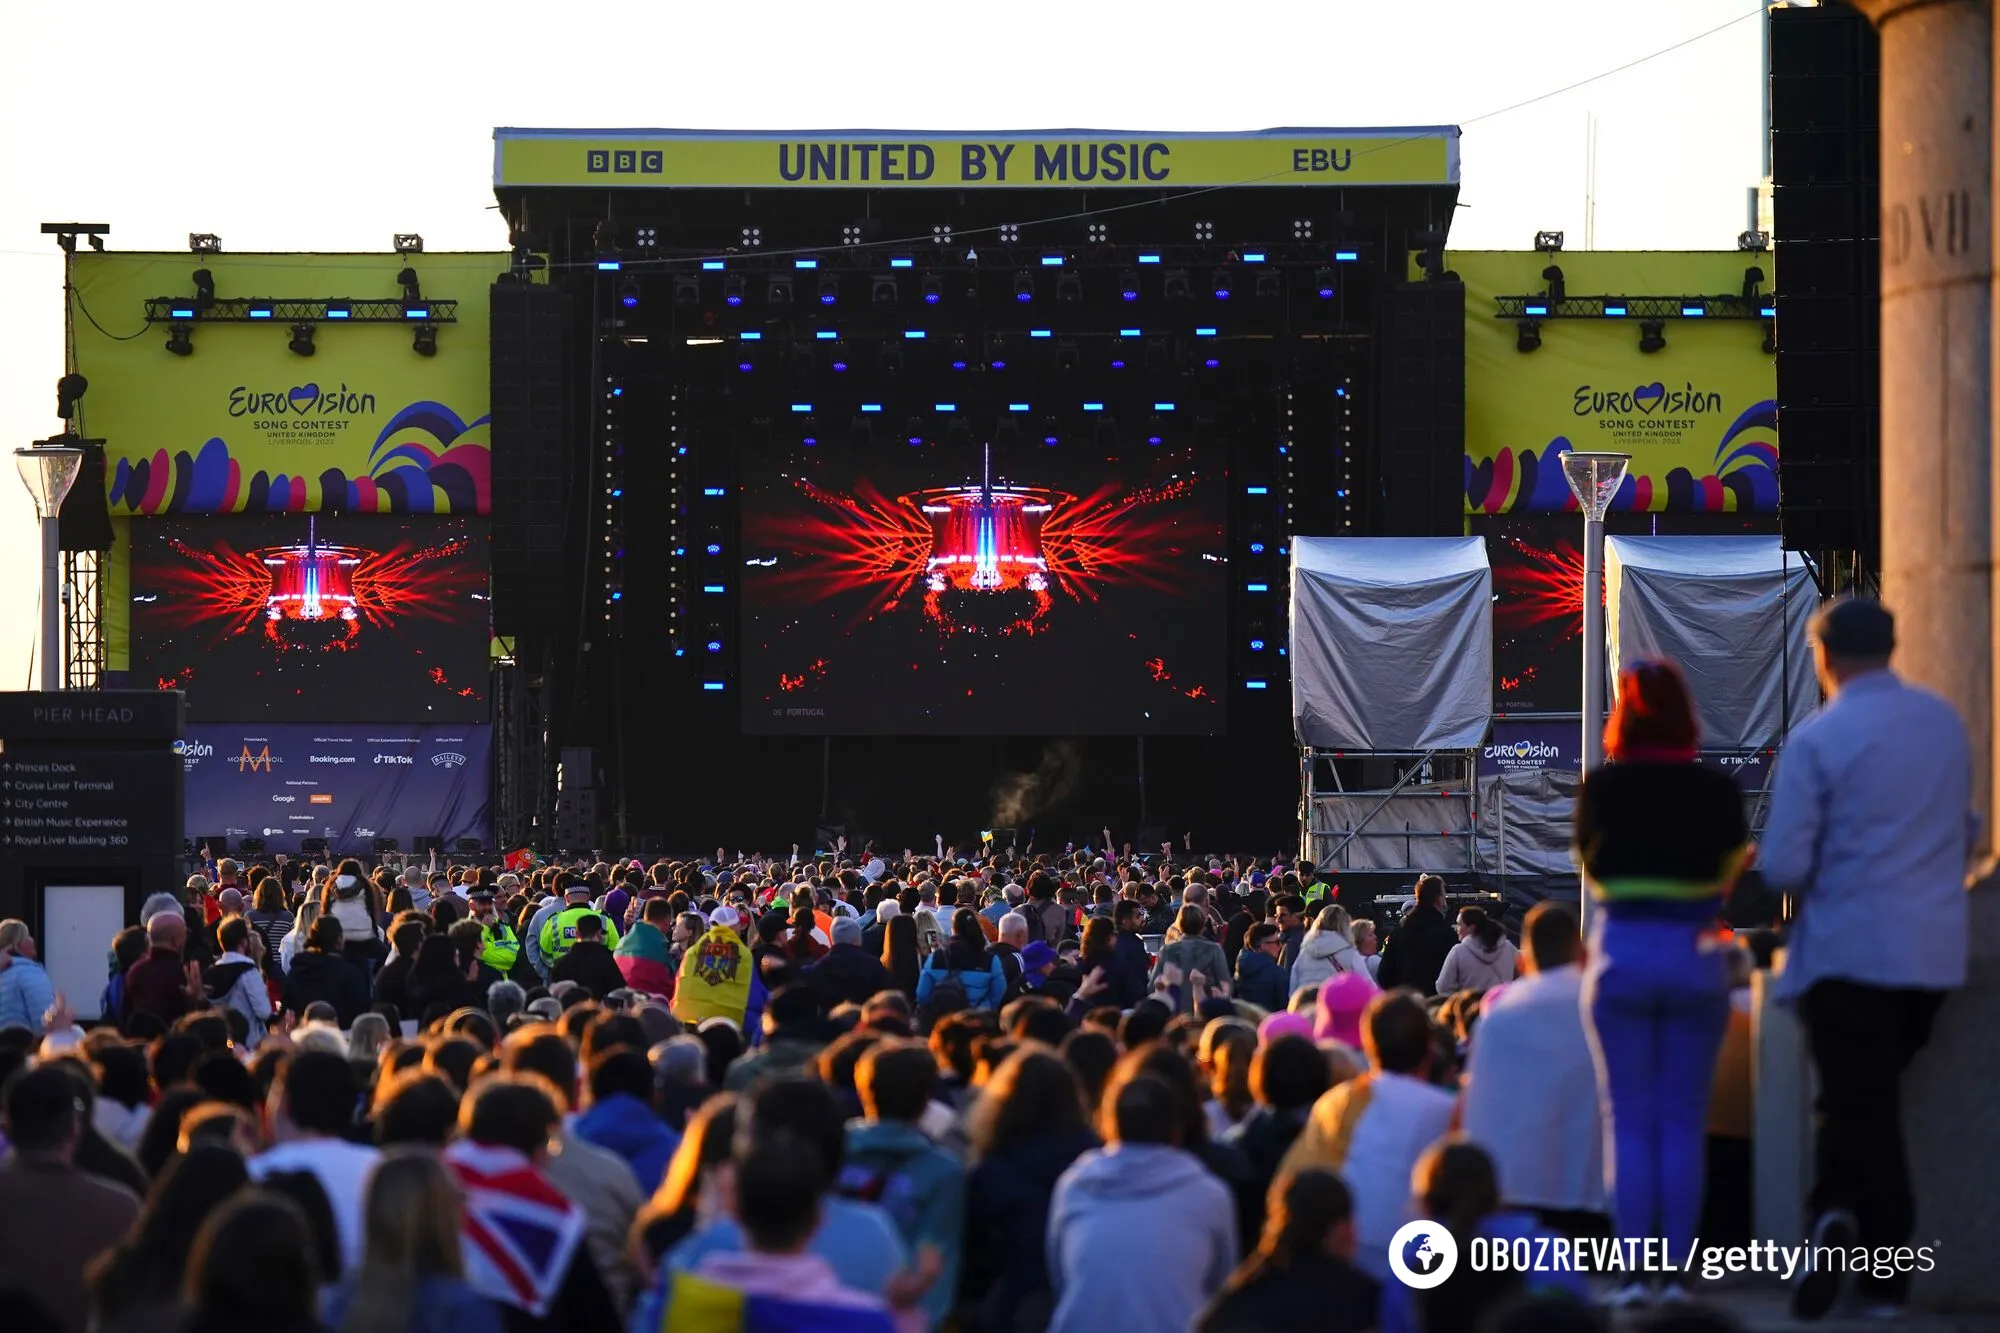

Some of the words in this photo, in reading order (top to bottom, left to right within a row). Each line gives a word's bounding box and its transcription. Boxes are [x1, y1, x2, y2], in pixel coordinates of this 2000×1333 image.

[590, 153, 660, 171] BBC
[779, 144, 934, 181] UNITED
[961, 144, 1015, 181] BY
[1034, 143, 1170, 181] MUSIC
[1293, 149, 1351, 172] EBU
[253, 420, 288, 430] SONG
[292, 420, 350, 430] CONTEST
[1599, 419, 1634, 429] SONG
[1638, 419, 1695, 429] CONTEST
[268, 438, 312, 446] LIVERPOOL
[33, 708, 72, 722] PIER
[81, 708, 134, 722] HEAD
[787, 708, 825, 716] PORTUGAL
[309, 755, 356, 764] Booking.com
[383, 755, 413, 764] TikTok
[434, 754, 464, 763] BAILEYS
[15, 763, 49, 772] Princes
[51, 763, 76, 772] Dock
[15, 781, 45, 790] Cruise
[47, 781, 70, 790] Liner
[73, 780, 114, 790] Terminal
[15, 799, 34, 809] City
[36, 799, 68, 808] Centre
[272, 795, 296, 803] Google
[14, 817, 44, 827] British
[46, 817, 72, 827] Music
[75, 817, 128, 829] Experience
[14, 835, 40, 846] Royal
[43, 835, 66, 845] Liver
[68, 835, 107, 847] Building
[109, 836, 128, 845] 360
